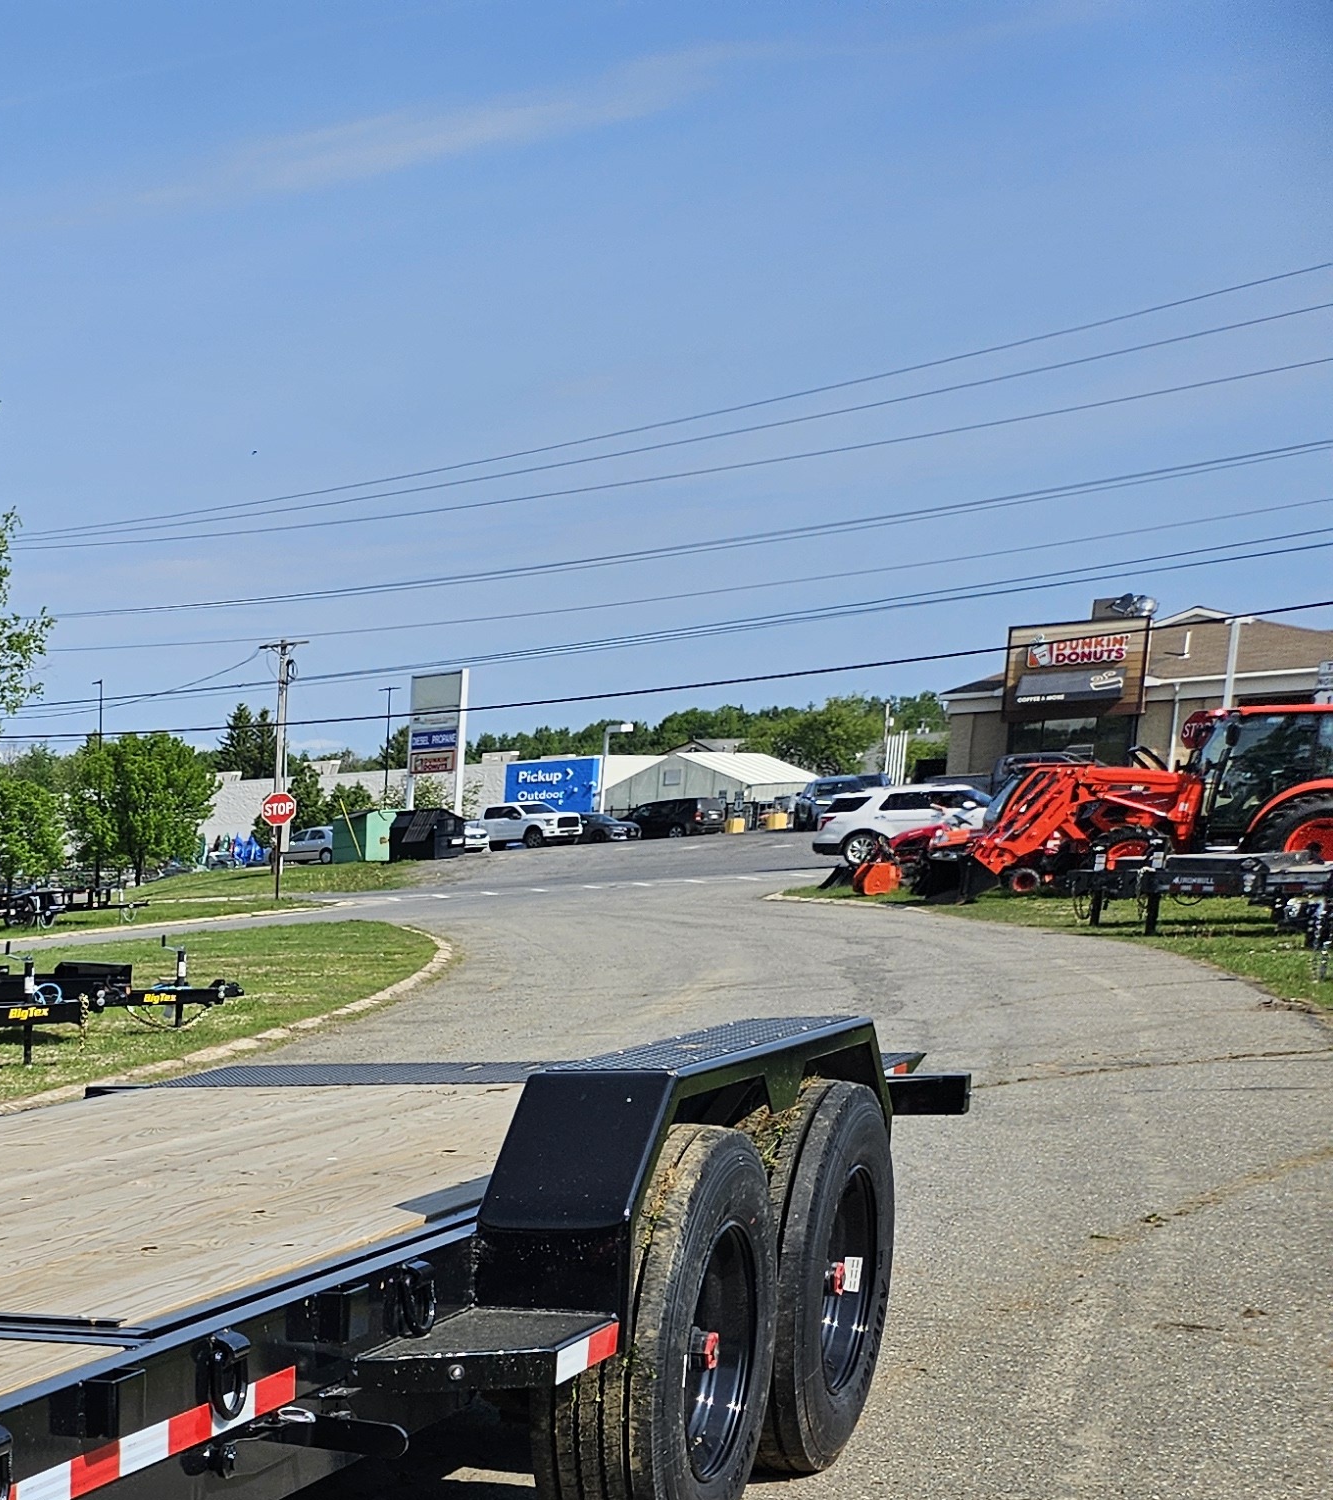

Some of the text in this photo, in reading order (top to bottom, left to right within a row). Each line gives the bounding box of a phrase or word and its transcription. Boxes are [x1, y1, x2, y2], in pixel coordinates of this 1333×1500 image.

[1055, 648, 1125, 663] DONUTS
[518, 769, 562, 784] Pickup
[517, 790, 564, 801] Outdoor
[264, 802, 294, 817] STOP
[144, 993, 176, 1004] BigTex
[8, 1007, 49, 1020] BigTex
